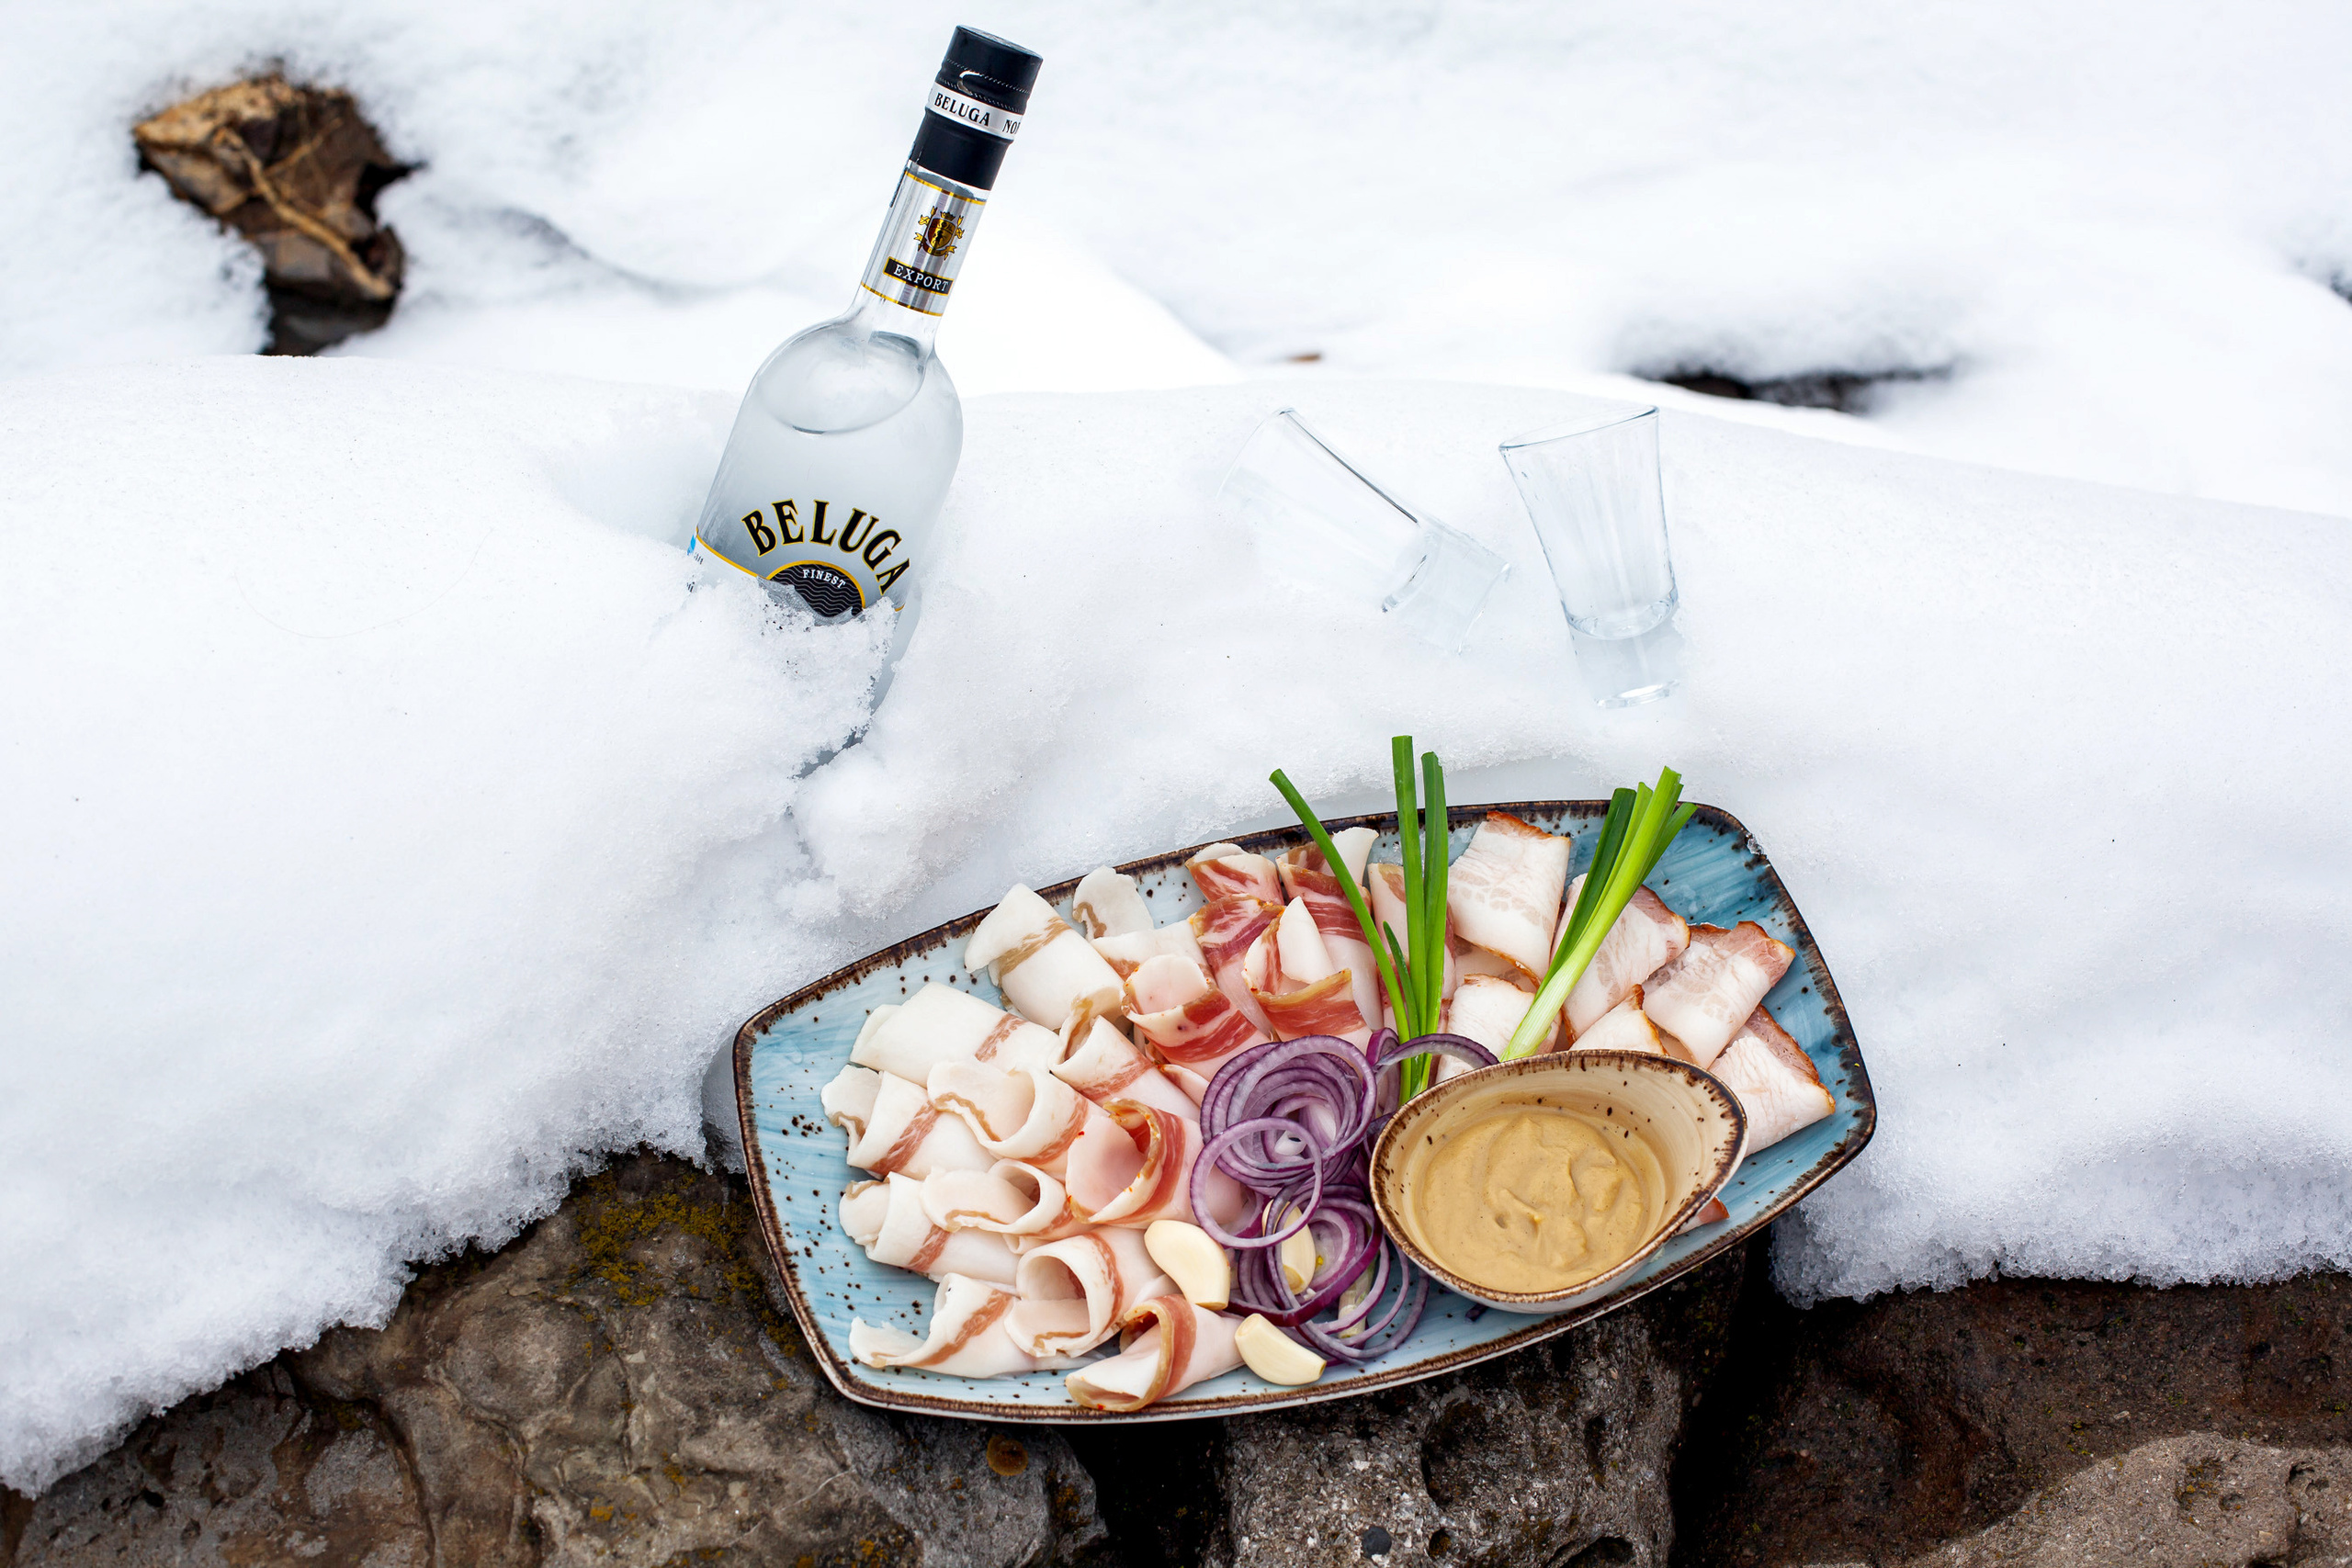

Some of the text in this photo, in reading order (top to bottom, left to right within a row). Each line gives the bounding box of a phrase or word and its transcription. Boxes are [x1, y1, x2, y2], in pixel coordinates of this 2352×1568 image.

[934, 93, 1021, 134] BELUGA NO
[894, 264, 949, 291] EXPORT
[741, 498, 910, 595] BELUGA
[802, 569, 846, 589] FINEST
